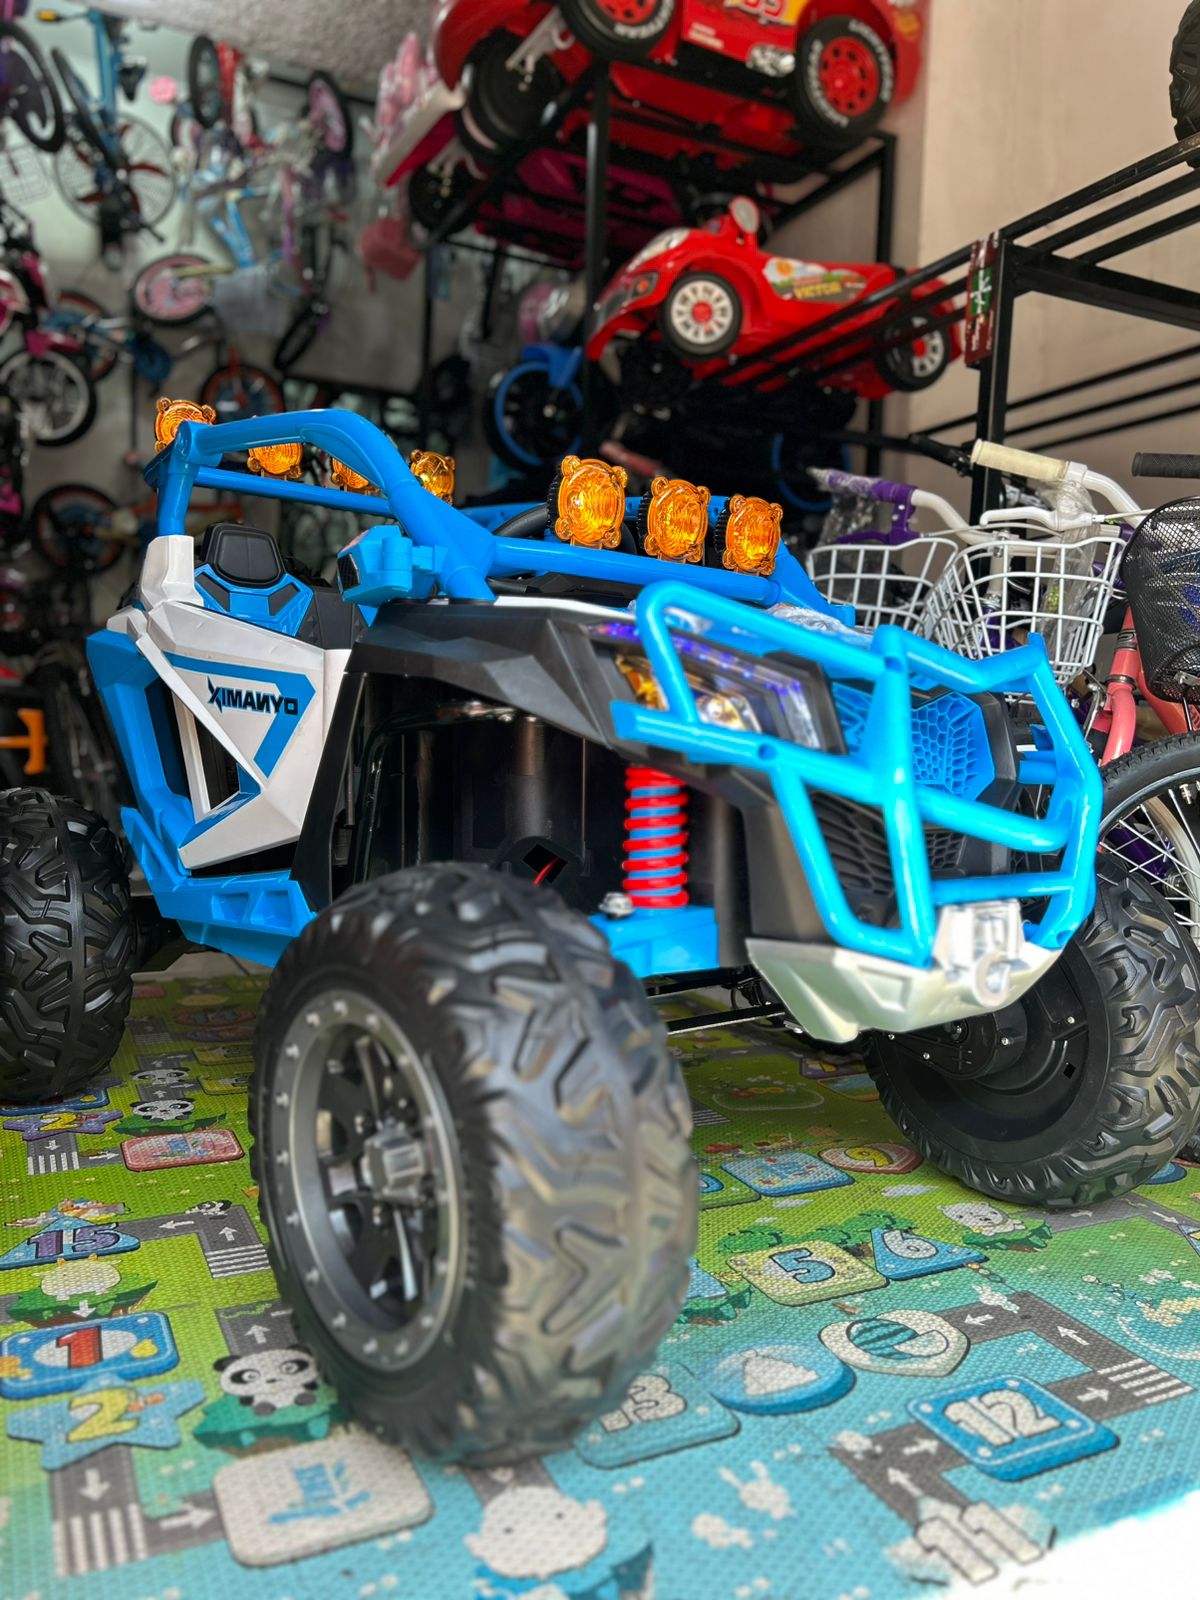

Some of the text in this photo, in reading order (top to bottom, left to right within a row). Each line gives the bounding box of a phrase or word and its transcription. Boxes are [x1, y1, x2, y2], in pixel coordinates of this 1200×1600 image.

[793, 281, 842, 299] VICTOR
[37, 1111, 82, 1132] 2
[844, 1147, 894, 1168] 9
[27, 1221, 121, 1259] 15
[880, 1229, 938, 1260] 6
[769, 1247, 836, 1284] 5
[56, 1325, 104, 1370] 1
[65, 1386, 141, 1443] 2
[943, 1388, 1063, 1448] 12
[914, 1502, 1046, 1588] 11
